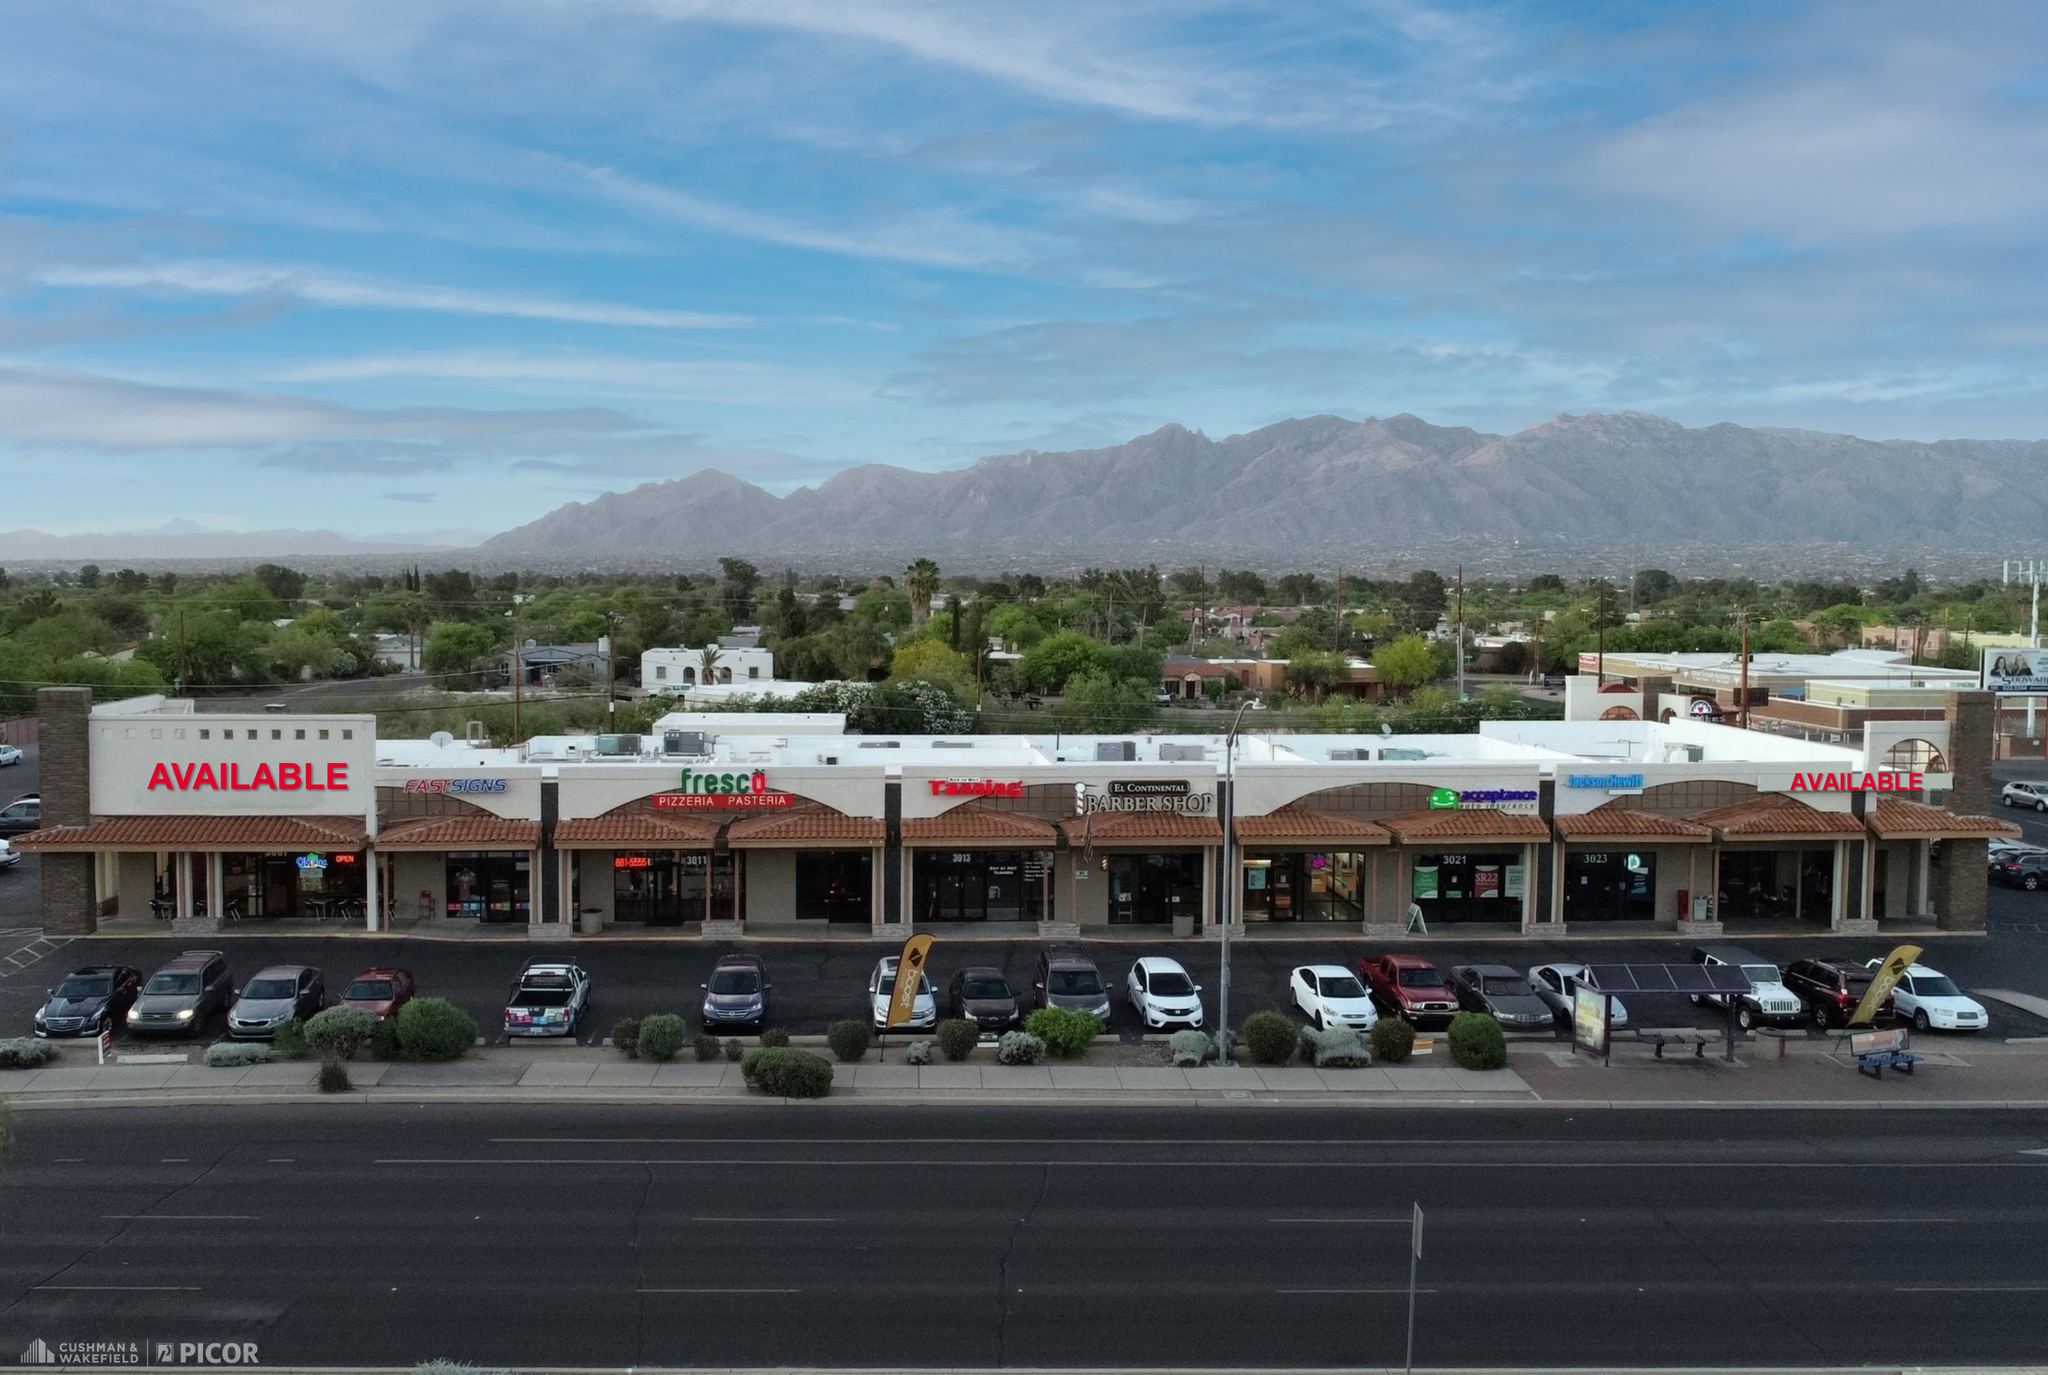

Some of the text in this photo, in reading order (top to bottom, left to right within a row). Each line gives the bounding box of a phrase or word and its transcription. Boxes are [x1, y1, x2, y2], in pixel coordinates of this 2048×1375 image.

[2002, 677, 2048, 685] SHOWAR
[681, 768, 766, 794] fresco
[1568, 773, 1644, 788] Jackson Hewitt
[403, 779, 508, 794] FASTSIGNS
[928, 779, 1023, 798] Tanning
[659, 795, 786, 806] PIZZERIA PASTERIA
[1461, 788, 1537, 803] acceptance
[1086, 793, 1213, 813] BARBER SHOP
[336, 855, 354, 863] OPEN
[686, 855, 707, 865] 3011
[953, 853, 971, 863] 3013
[1443, 855, 1466, 864] 3021
[1584, 854, 1607, 863] 3023
[1475, 873, 1498, 882] SR22
[901, 969, 918, 1009] boost
